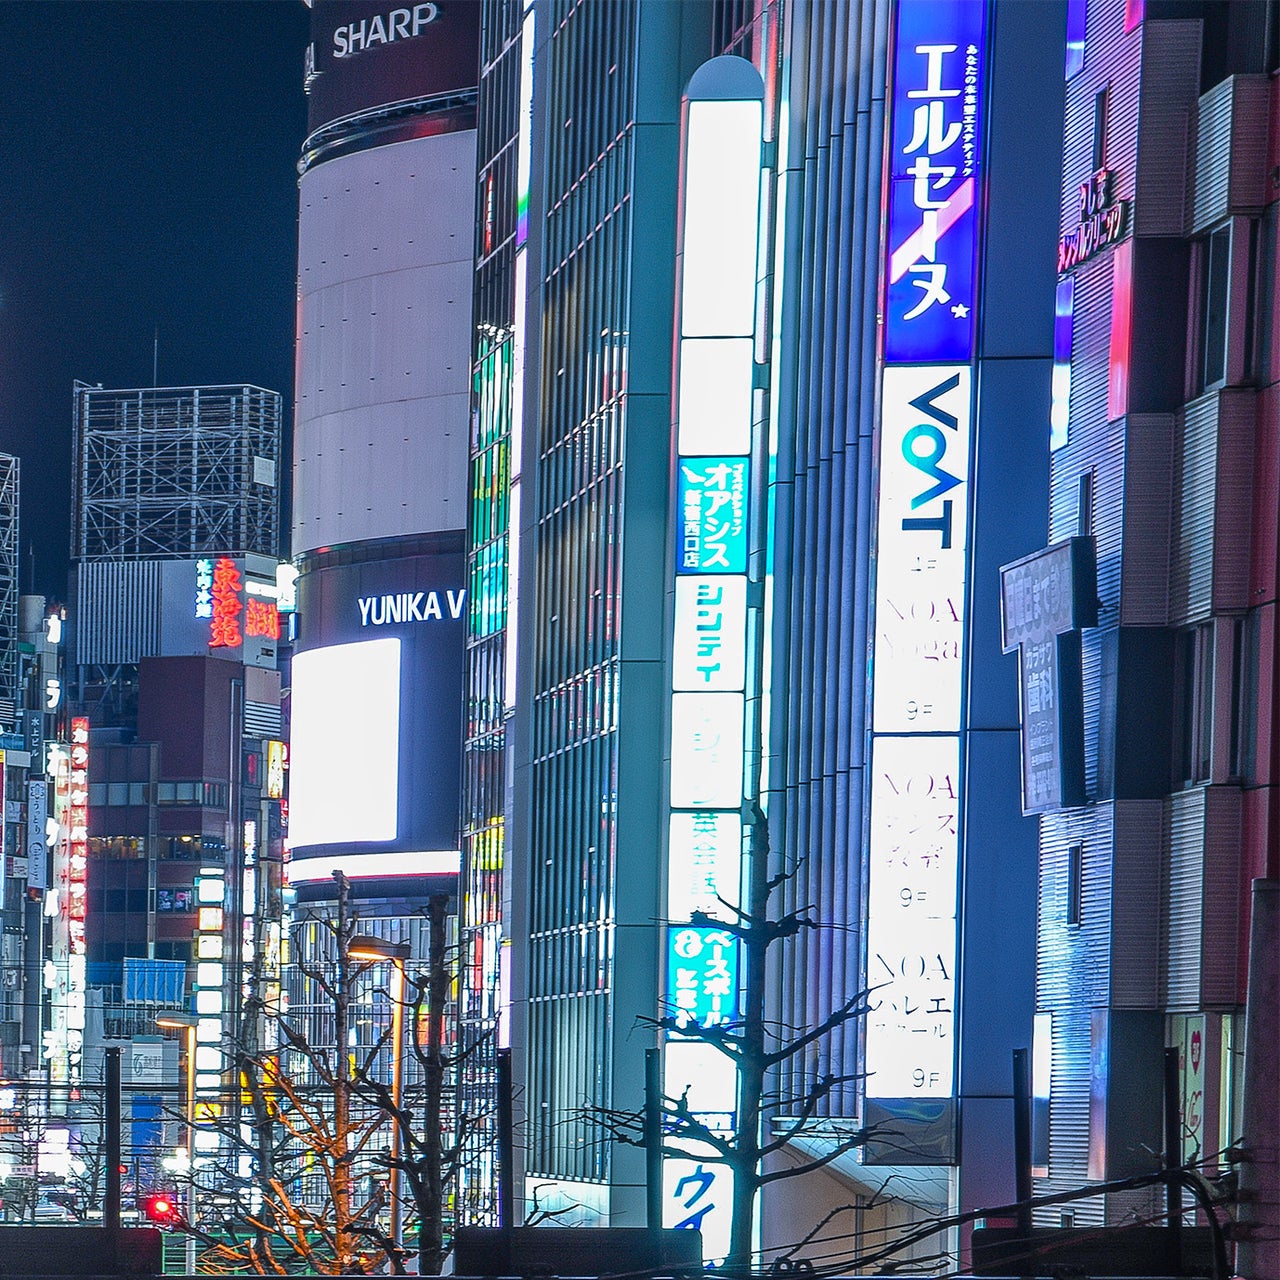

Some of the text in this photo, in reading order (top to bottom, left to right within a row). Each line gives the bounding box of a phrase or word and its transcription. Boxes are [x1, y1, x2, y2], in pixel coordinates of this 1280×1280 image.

[333, 2, 438, 59] SHARP
[903, 45, 963, 321] エルセーヌ
[683, 488, 701, 569] 新宿西口店
[702, 462, 733, 570] オアシス
[358, 593, 441, 626] YUNIKA
[1027, 667, 1055, 716] 歯科
